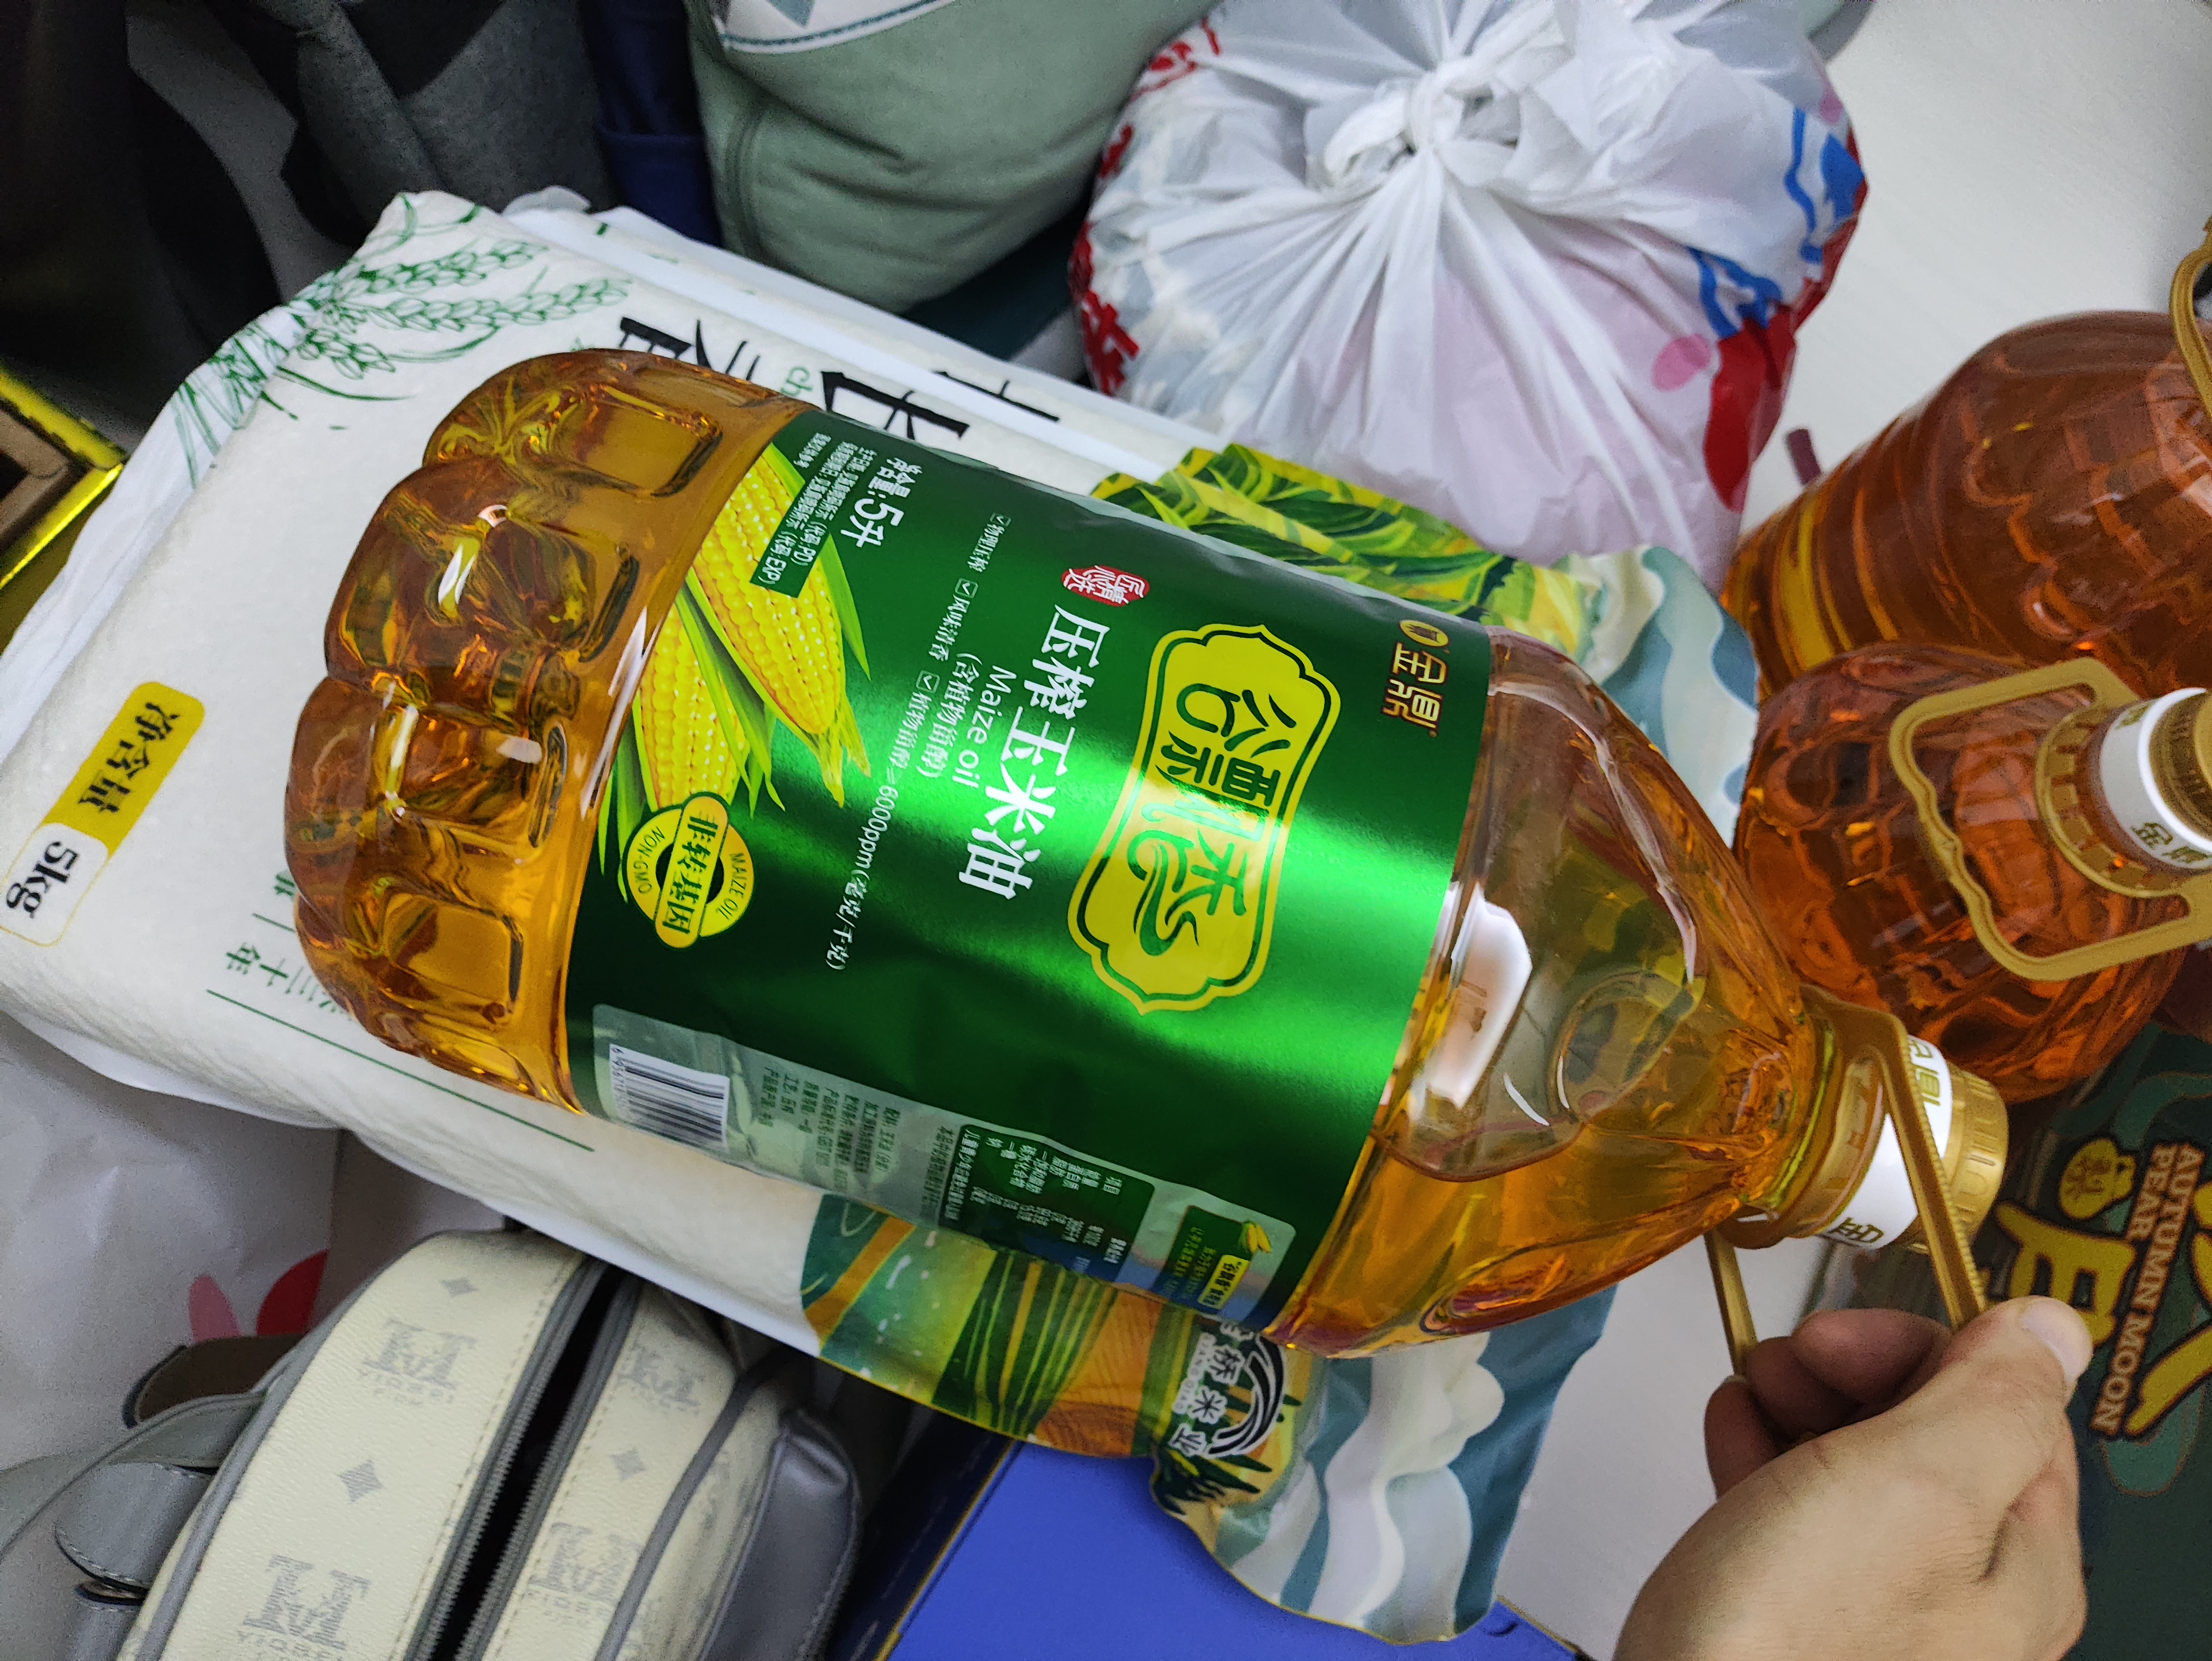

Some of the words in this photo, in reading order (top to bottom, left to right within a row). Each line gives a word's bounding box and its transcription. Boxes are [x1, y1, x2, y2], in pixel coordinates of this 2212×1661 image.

[927, 594, 969, 663] 风味清香
[964, 664, 1017, 745] Maize
[1379, 641, 1446, 730] 金鼎
[78, 702, 182, 813] 净含量
[951, 747, 981, 789] oil
[955, 604, 1110, 901] 压榨玉米油
[632, 826, 665, 893] NON-GMO
[1128, 695, 1296, 956] 谷飘香
[6, 841, 79, 918] 5kg
[662, 811, 718, 935] 非转基因
[715, 900, 738, 920] OIL
[729, 853, 746, 899] MAIZE
[1008, 1143, 1037, 1189] 碳水化合物
[1101, 1175, 1123, 1196] 项目
[2126, 1143, 2176, 1240] PEAR
[2132, 1142, 2204, 1312] AUTUMN
[2091, 1313, 2155, 1435] MOON
